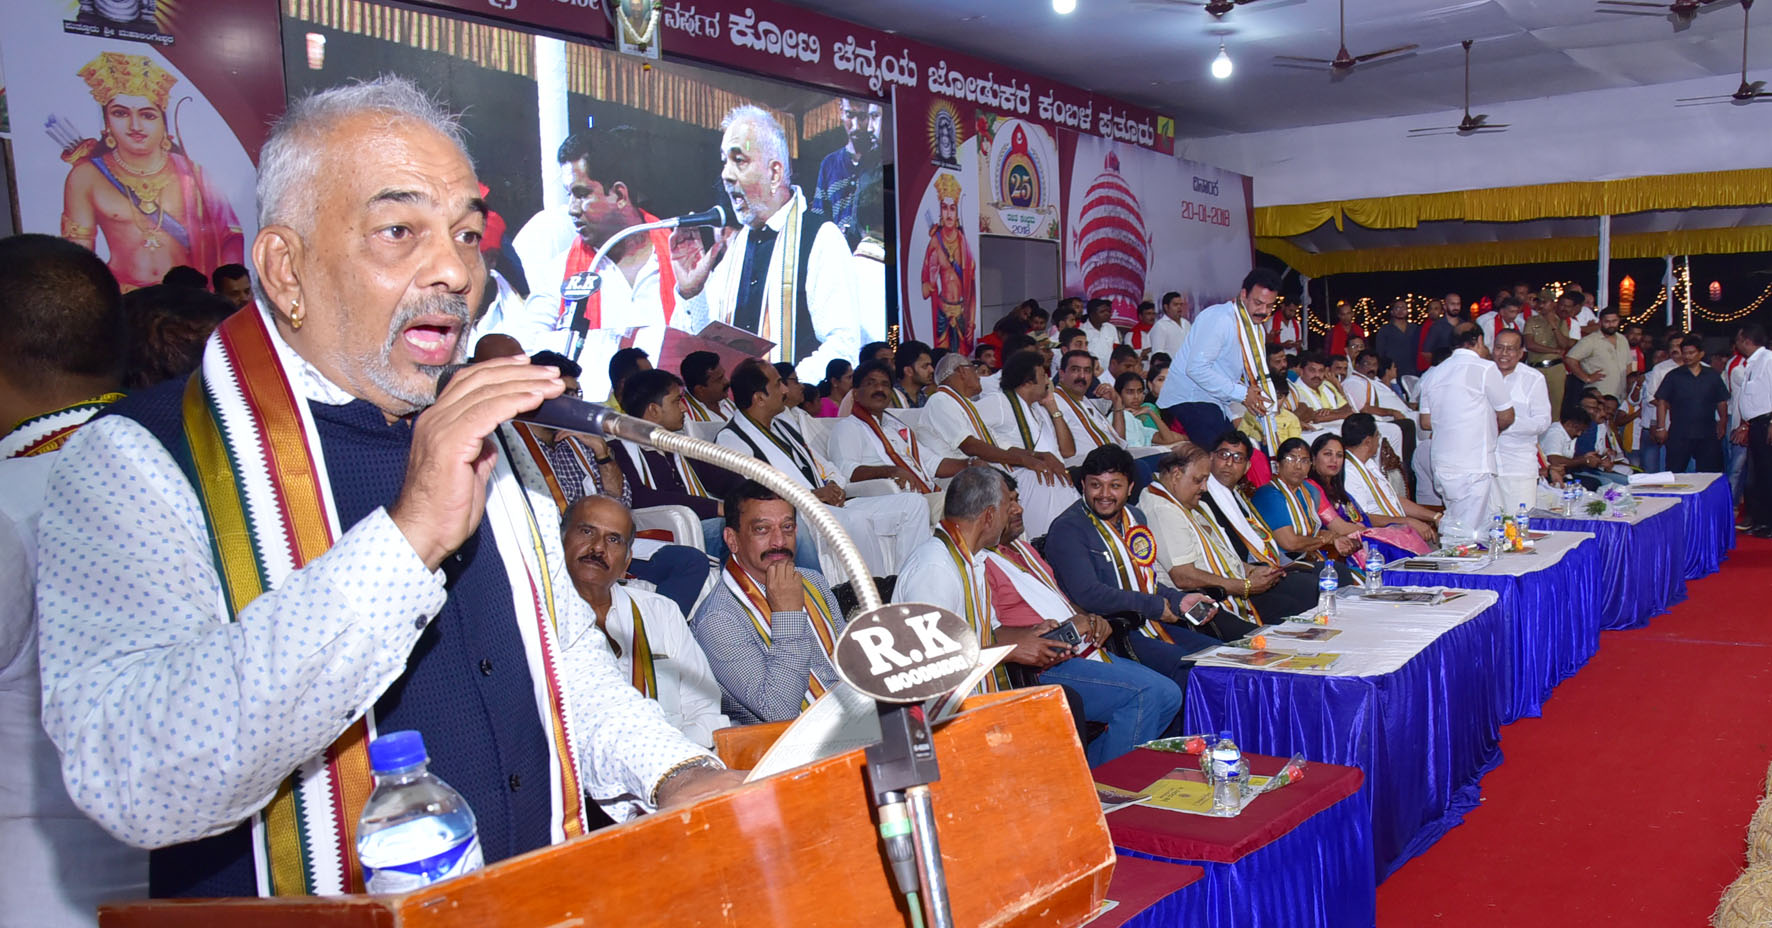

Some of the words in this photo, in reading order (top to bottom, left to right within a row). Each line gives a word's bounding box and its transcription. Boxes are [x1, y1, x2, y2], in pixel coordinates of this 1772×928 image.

[664, 2, 720, 38] ವರ್ಷದ
[728, 8, 820, 64] ಕೋಟಿ
[833, 33, 917, 97] ಚೆನ್ನಯ
[928, 60, 1031, 114] ಜೋಡುಕರೆ
[1038, 89, 1092, 130] ಕಂಬಳ
[1010, 172, 1031, 200] 25
[1181, 201, 1230, 227] 20-01-2018
[850, 611, 963, 676] R.K
